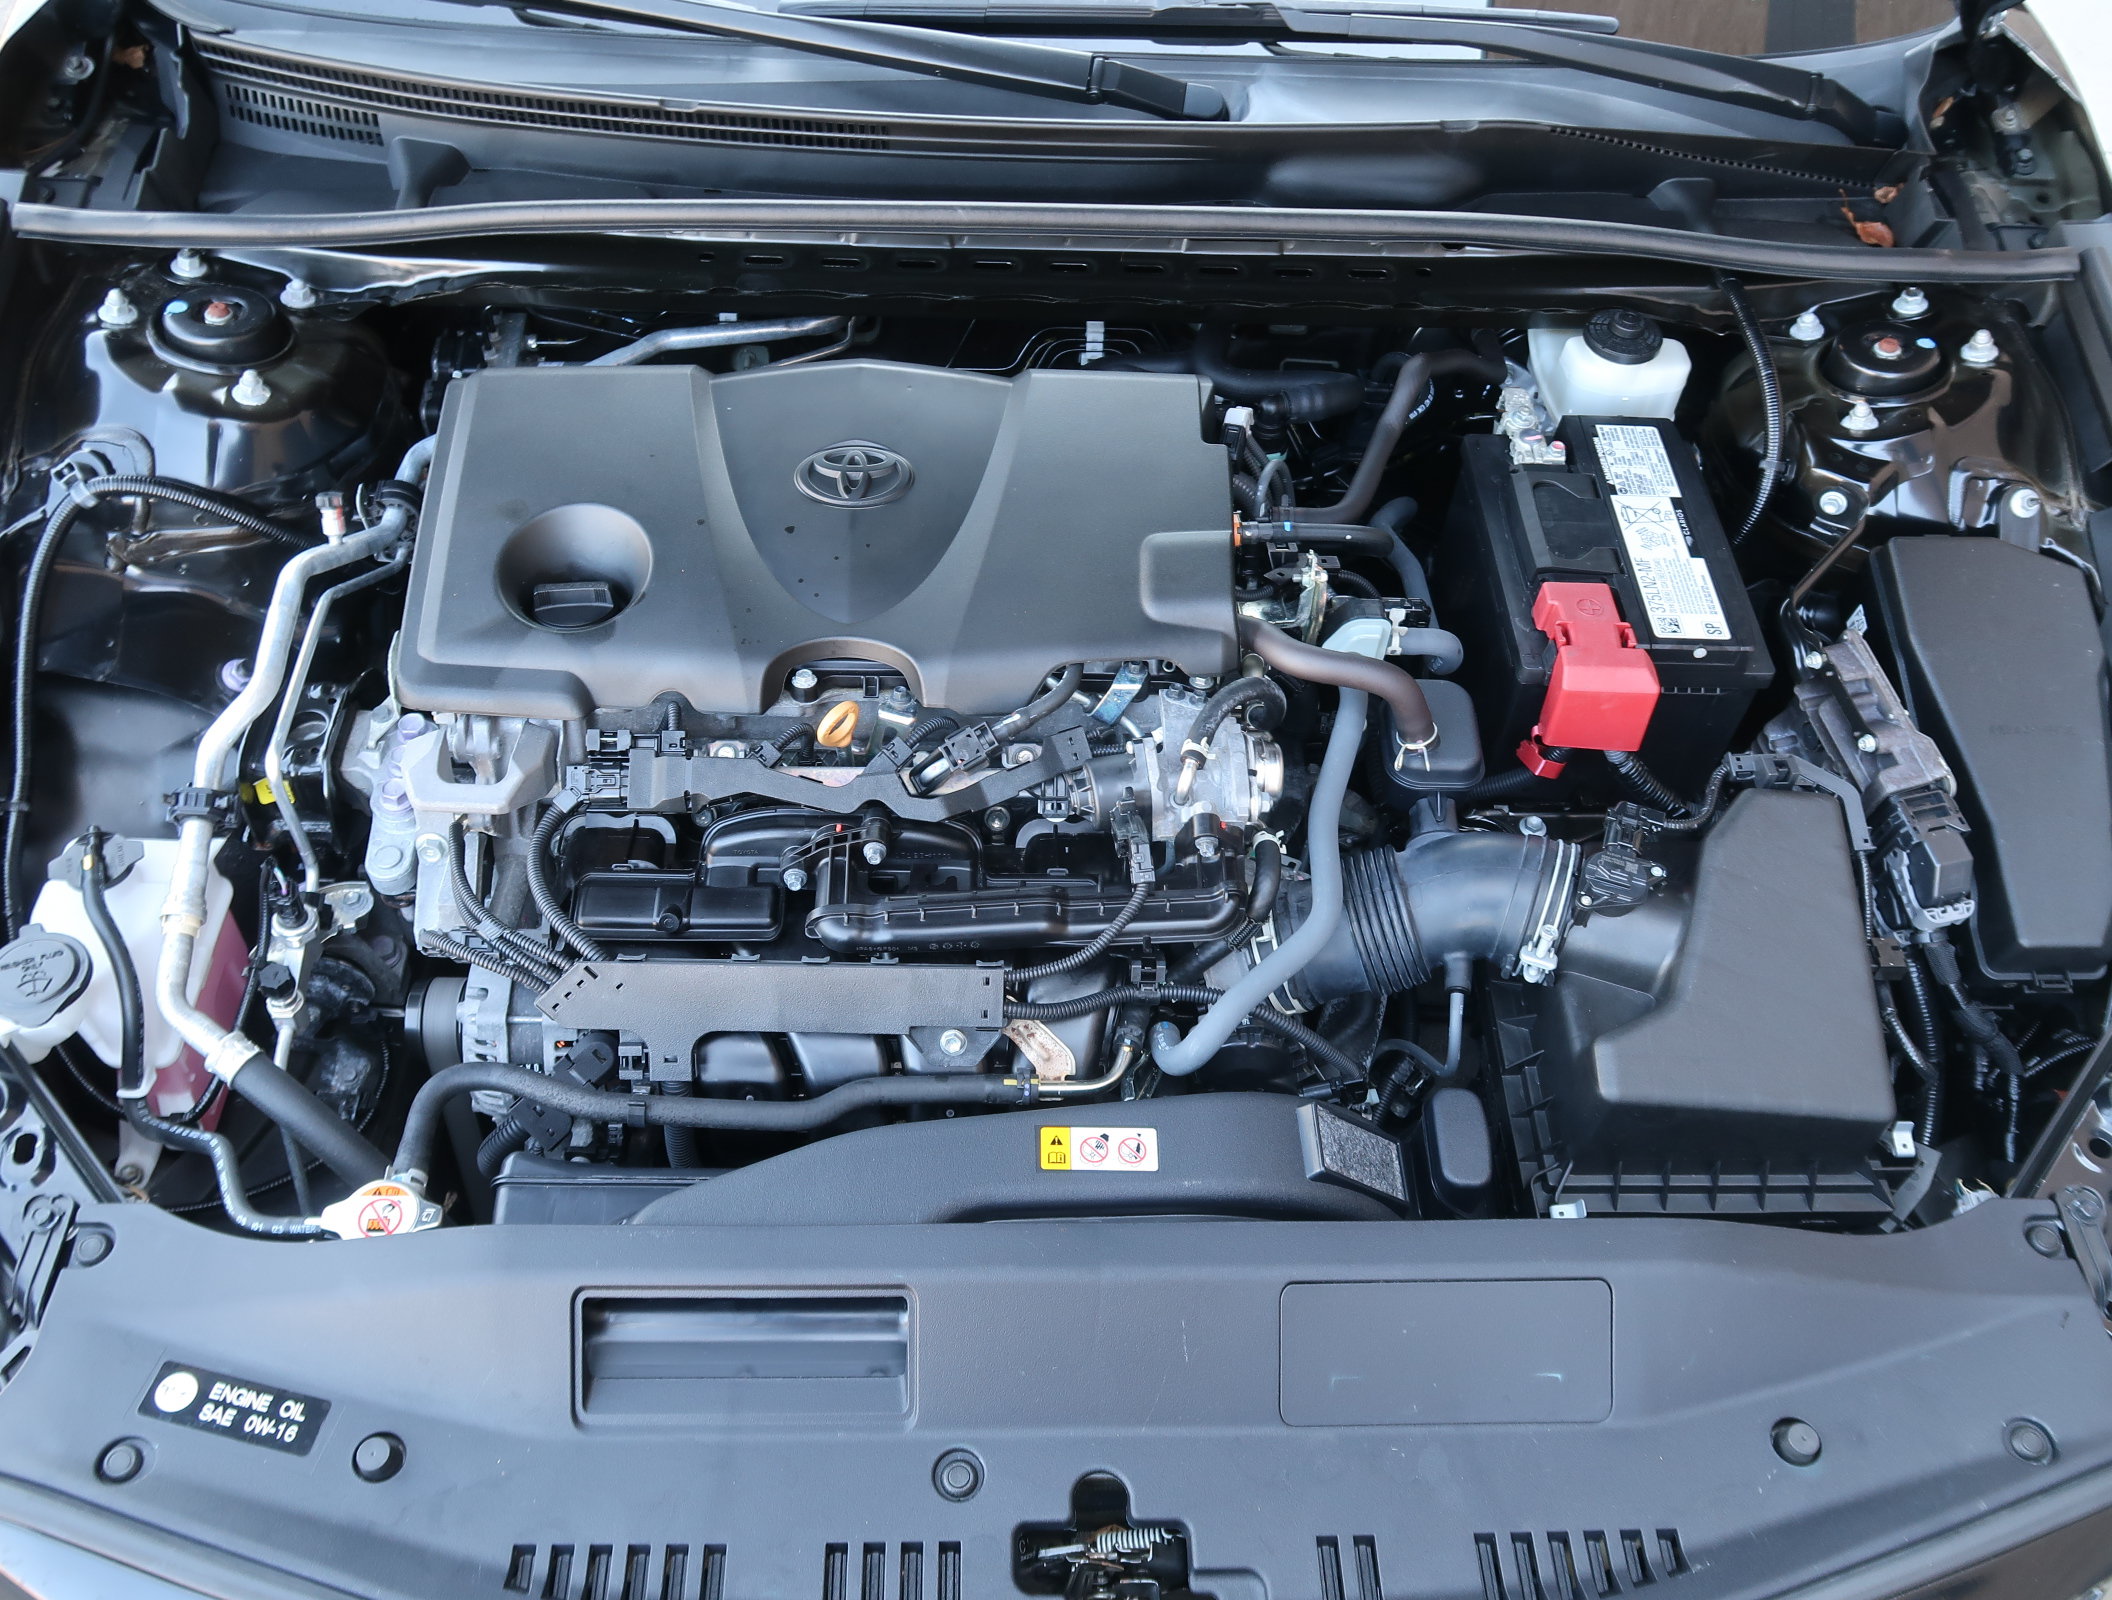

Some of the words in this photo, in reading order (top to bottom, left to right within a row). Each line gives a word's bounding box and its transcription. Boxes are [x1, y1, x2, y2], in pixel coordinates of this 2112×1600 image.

[1676, 509, 1691, 536] CLARIOS
[1634, 557, 1666, 613] 375LN2-MF
[1704, 622, 1723, 635] SP
[208, 1380, 273, 1413] ENGINE
[279, 1399, 306, 1423] OIL
[198, 1402, 238, 1427] SAE
[243, 1414, 299, 1443] 0W-16
